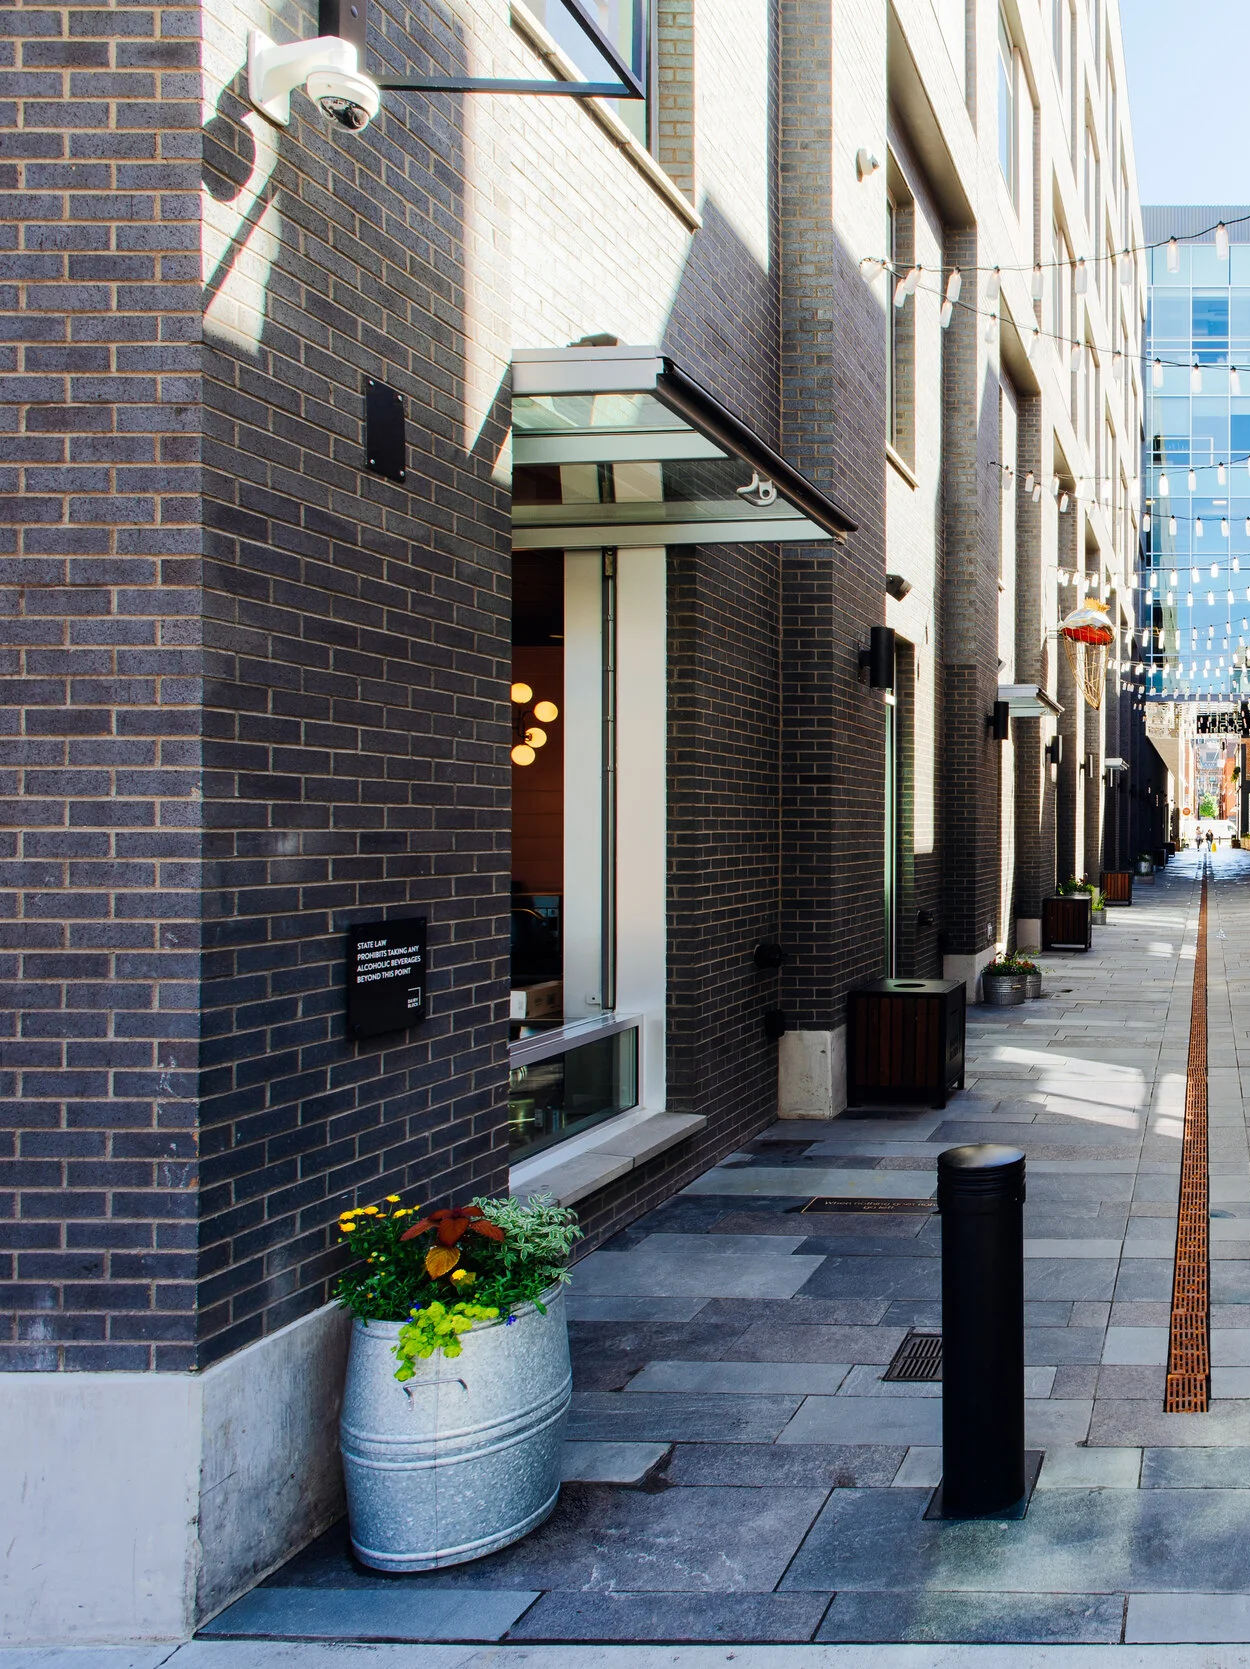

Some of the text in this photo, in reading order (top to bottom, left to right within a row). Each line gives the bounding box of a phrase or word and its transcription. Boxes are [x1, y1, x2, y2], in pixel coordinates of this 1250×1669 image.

[357, 939, 387, 950] STATE LAW
[357, 945, 419, 961] PROHIBITS TAKING ANY
[357, 955, 421, 972] ALCOHOLIC BEVERAGES
[357, 967, 411, 984] BEYOND THIS POINT
